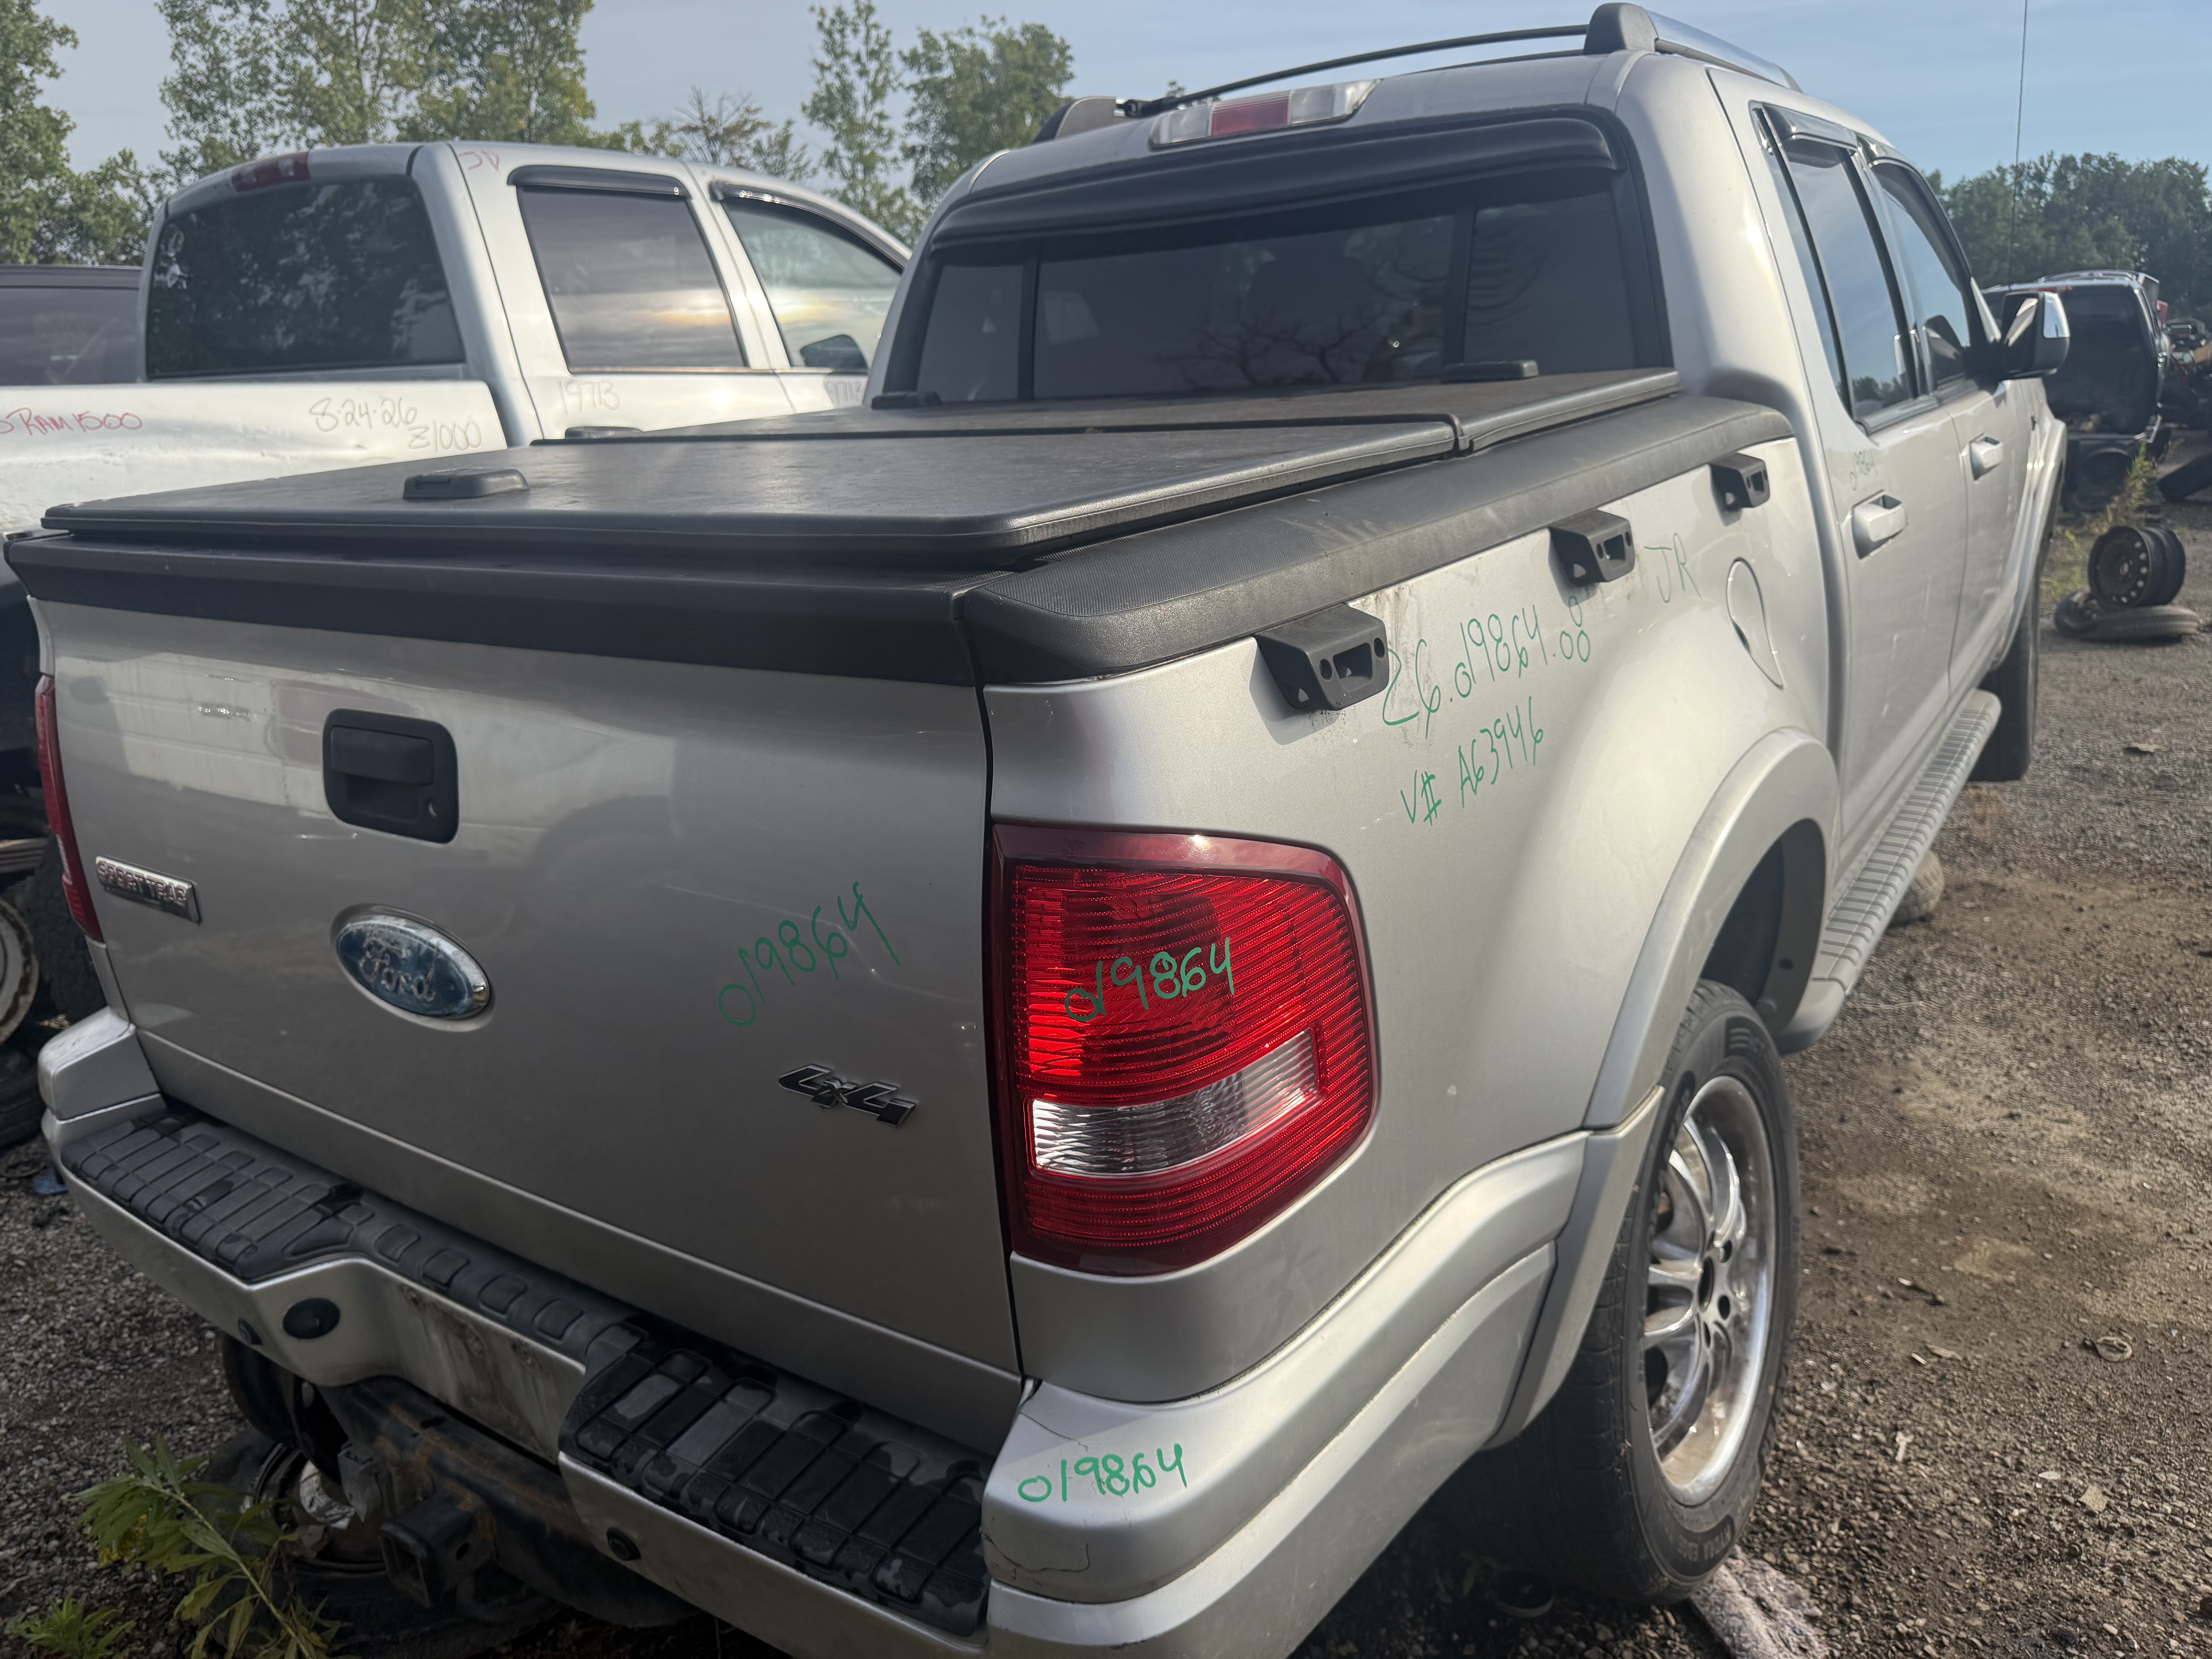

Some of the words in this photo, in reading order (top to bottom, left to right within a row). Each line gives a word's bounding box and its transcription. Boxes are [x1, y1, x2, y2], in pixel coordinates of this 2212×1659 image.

[97, 860, 144, 894] SPORT
[145, 874, 187, 906] TRAC
[359, 936, 436, 1003] Ford
[718, 881, 900, 1027] 019864
[1064, 936, 1235, 1022] 019864
[1018, 1443, 1187, 1502] 019864
